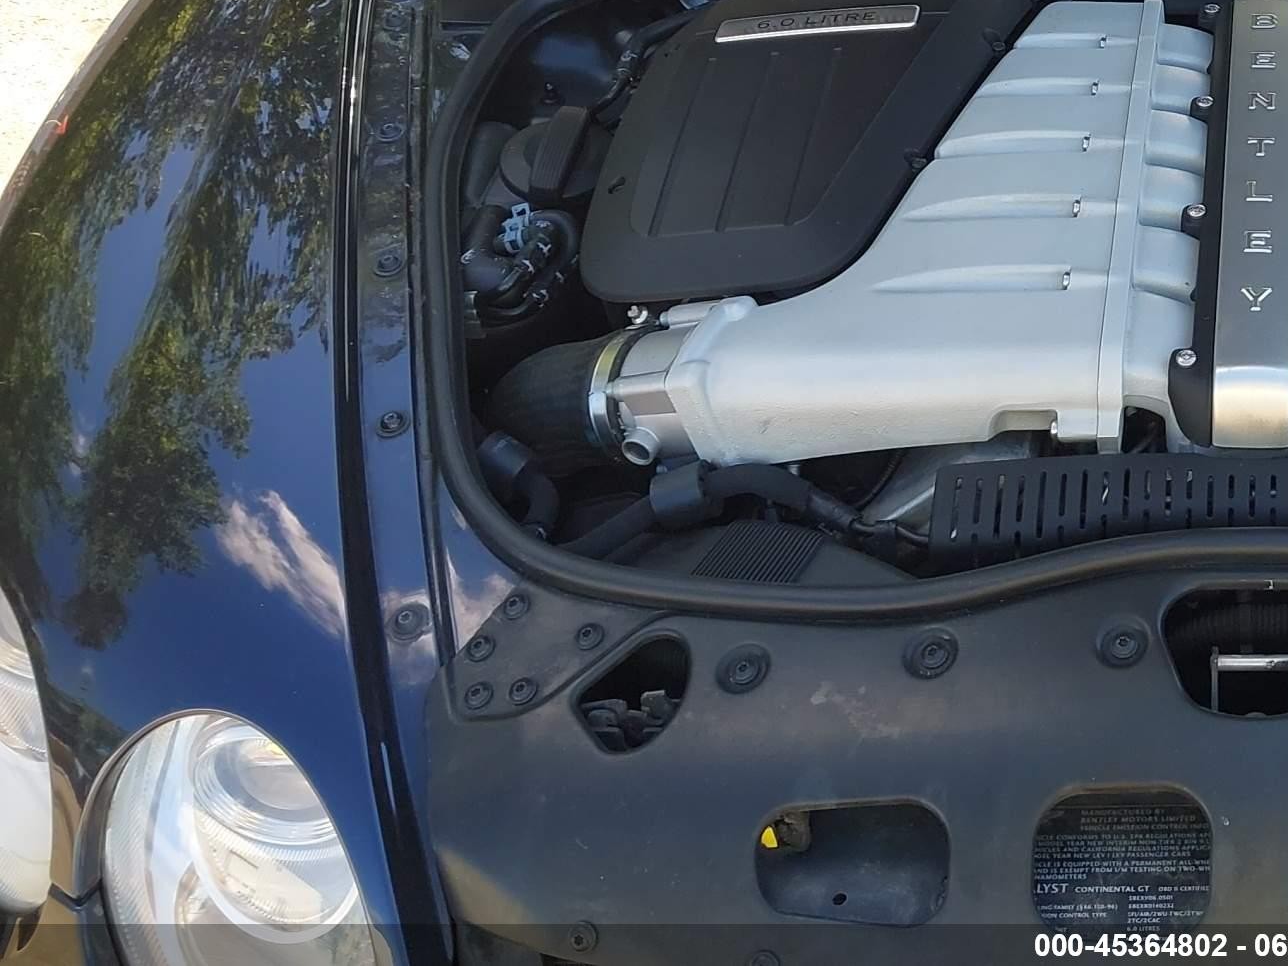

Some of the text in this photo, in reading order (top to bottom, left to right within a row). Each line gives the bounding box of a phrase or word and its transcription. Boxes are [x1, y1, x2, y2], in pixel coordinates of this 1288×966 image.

[758, 10, 877, 29] 6.0 LITRE
[1241, 14, 1281, 311] BENTLEY
[1074, 885, 1136, 893] CONTINENTAL
[1137, 885, 1150, 893] GT
